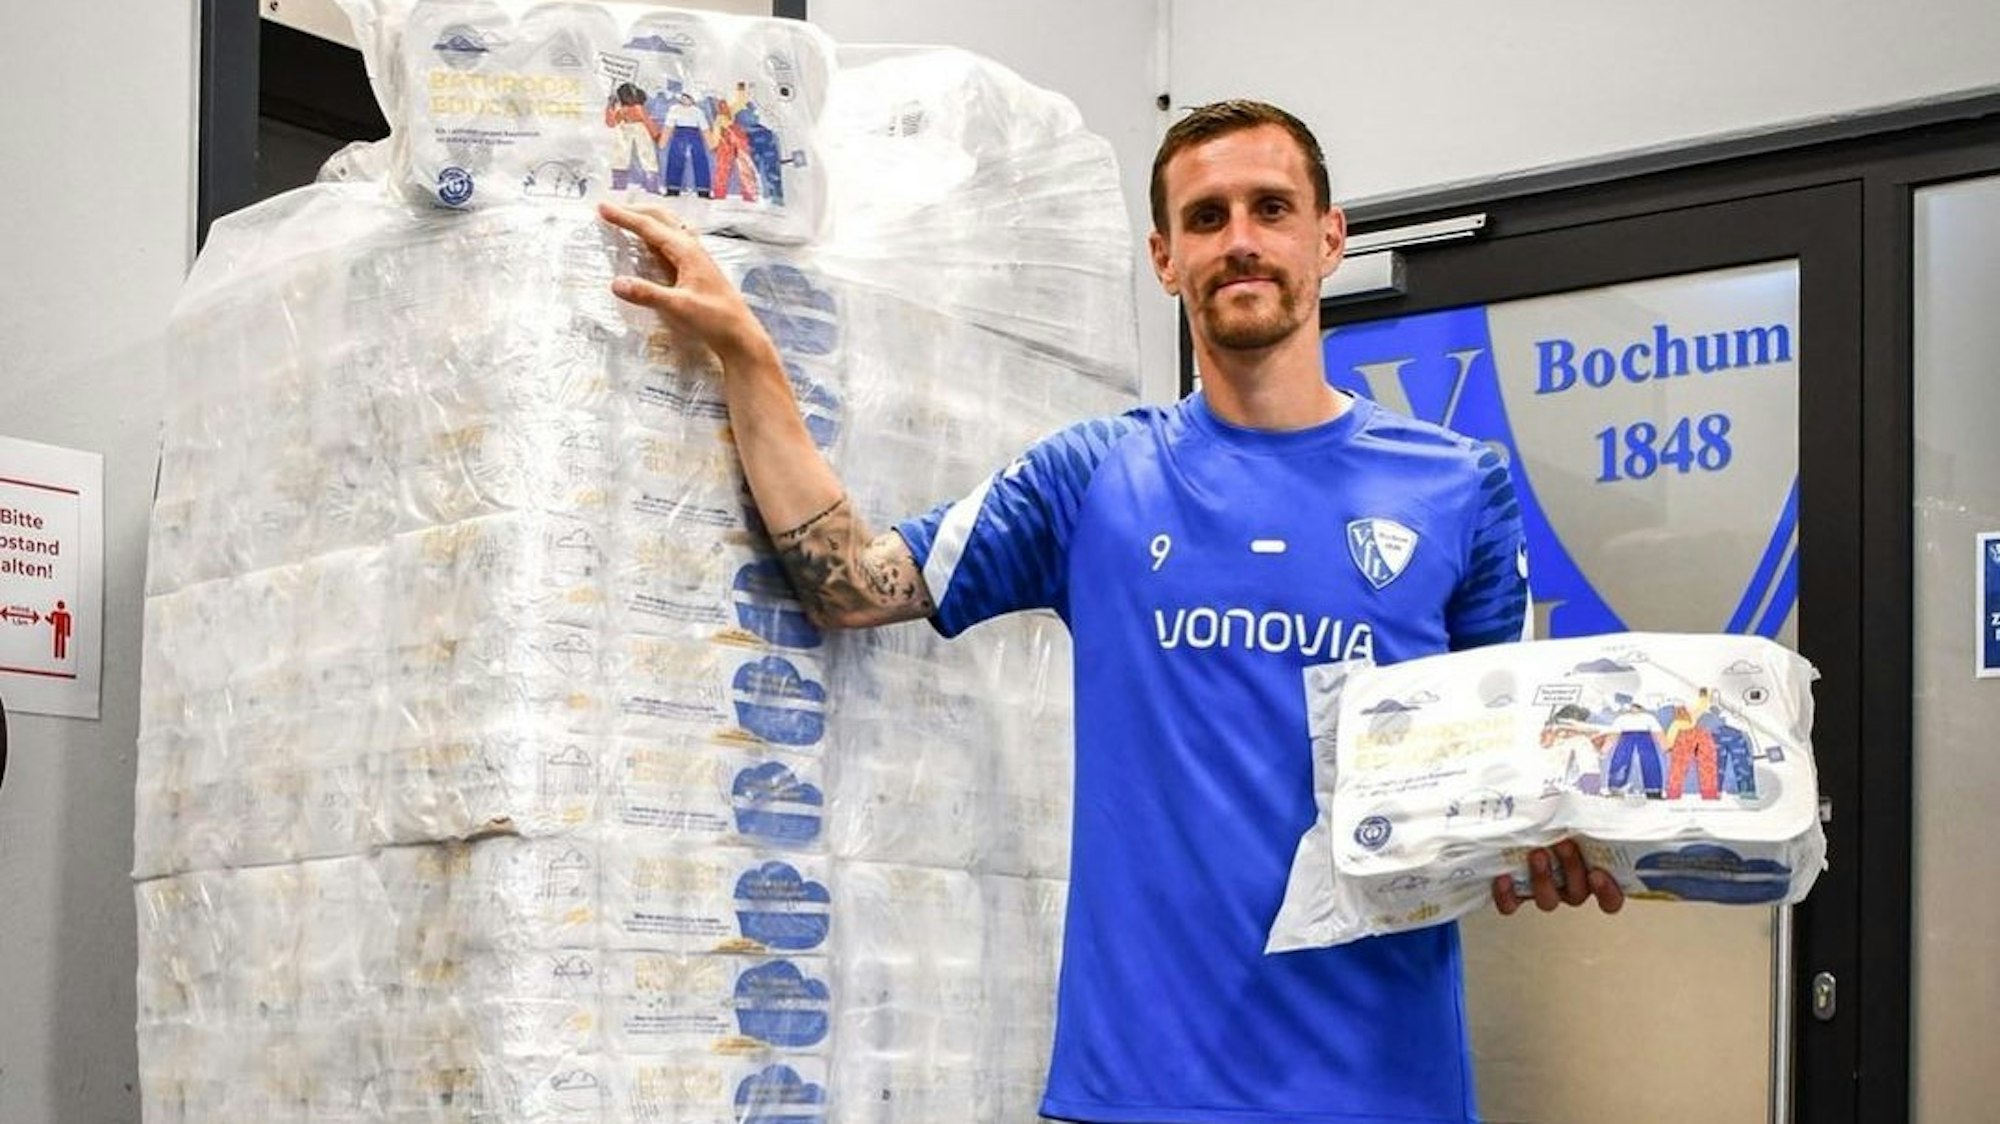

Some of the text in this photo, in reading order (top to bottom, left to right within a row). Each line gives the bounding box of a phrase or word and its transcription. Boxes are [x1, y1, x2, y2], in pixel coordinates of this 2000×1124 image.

[1534, 322, 1793, 394] Bochum
[1595, 414, 1733, 483] 1848
[1, 508, 43, 530] Bitte
[1150, 534, 1171, 571] 9
